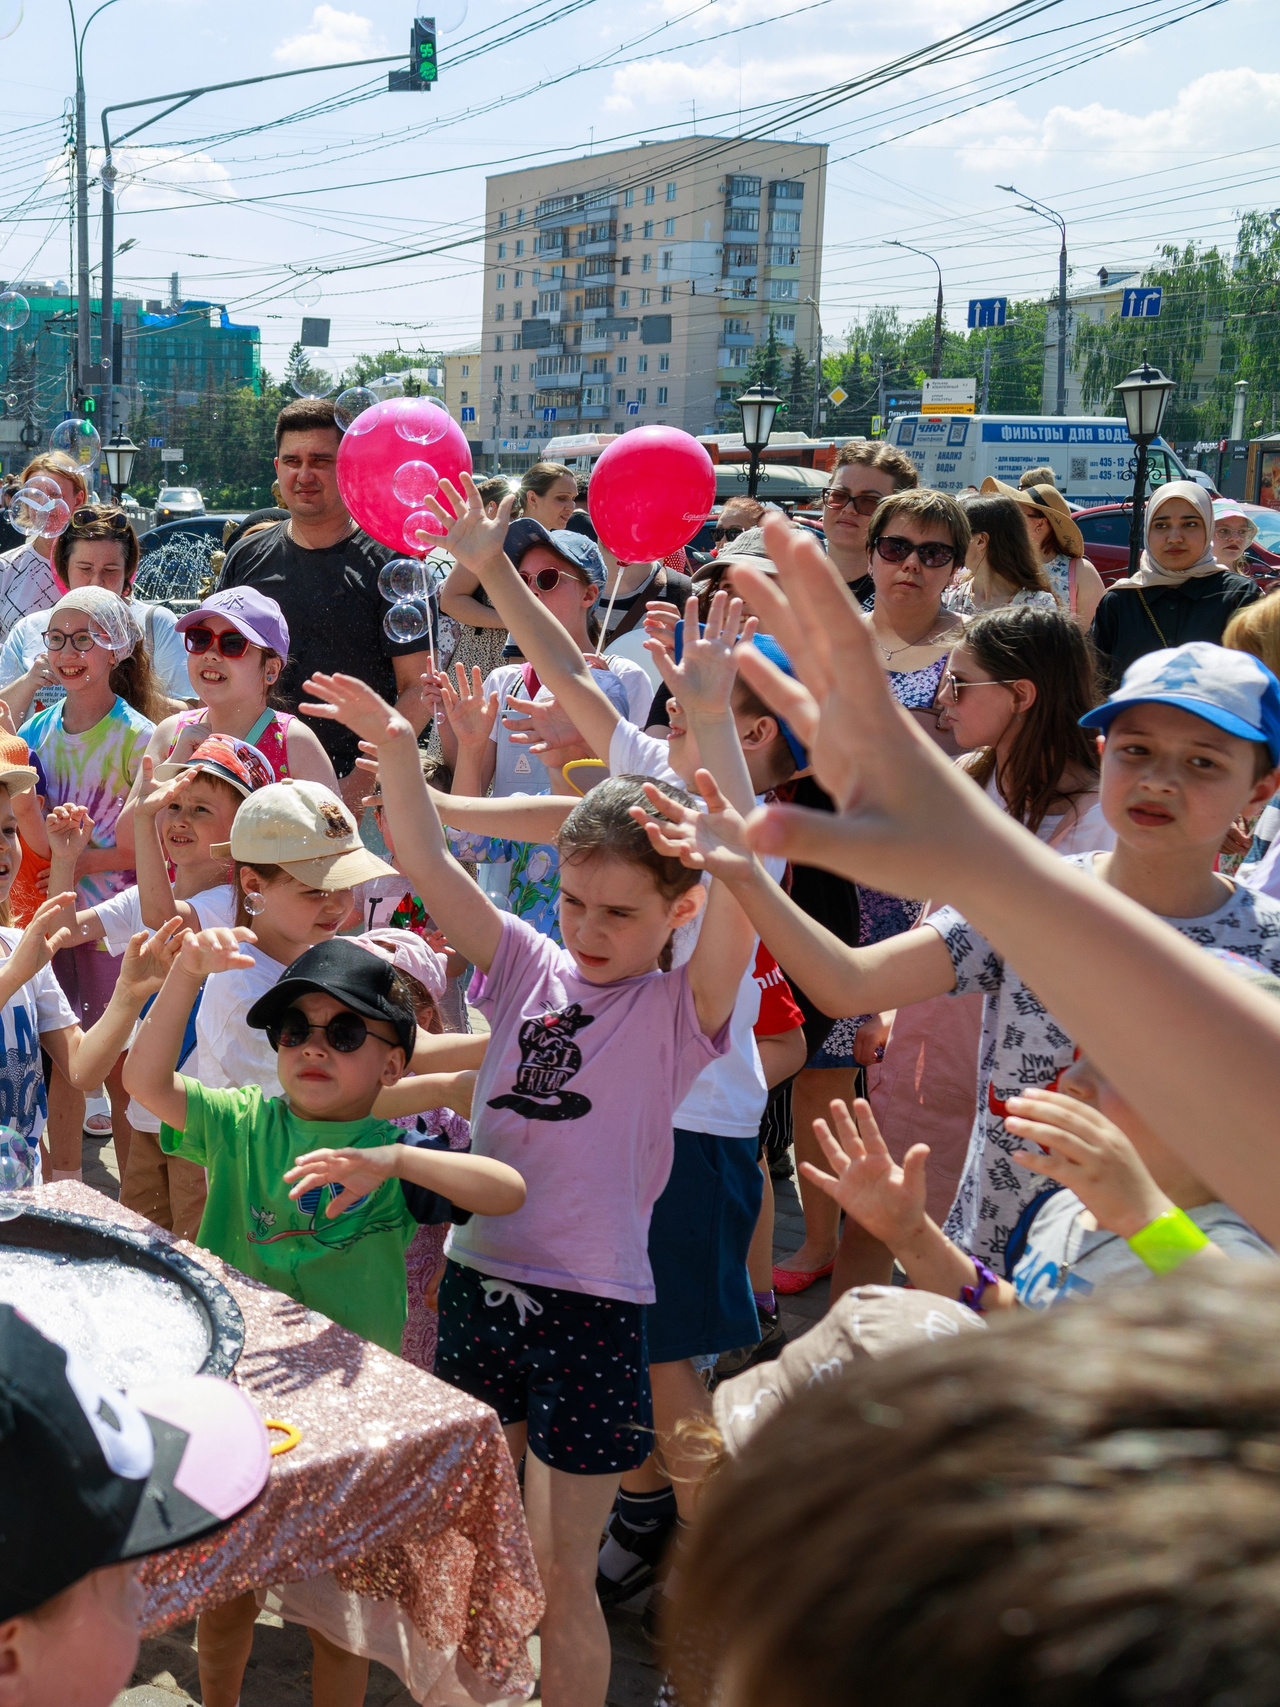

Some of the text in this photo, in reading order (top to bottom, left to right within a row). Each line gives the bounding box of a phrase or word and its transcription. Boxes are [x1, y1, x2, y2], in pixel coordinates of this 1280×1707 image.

[420, 43, 434, 58] 55
[905, 451, 963, 460] ЛЬТРЫ АНАЛИЗ
[936, 463, 956, 473] ВОДЫ
